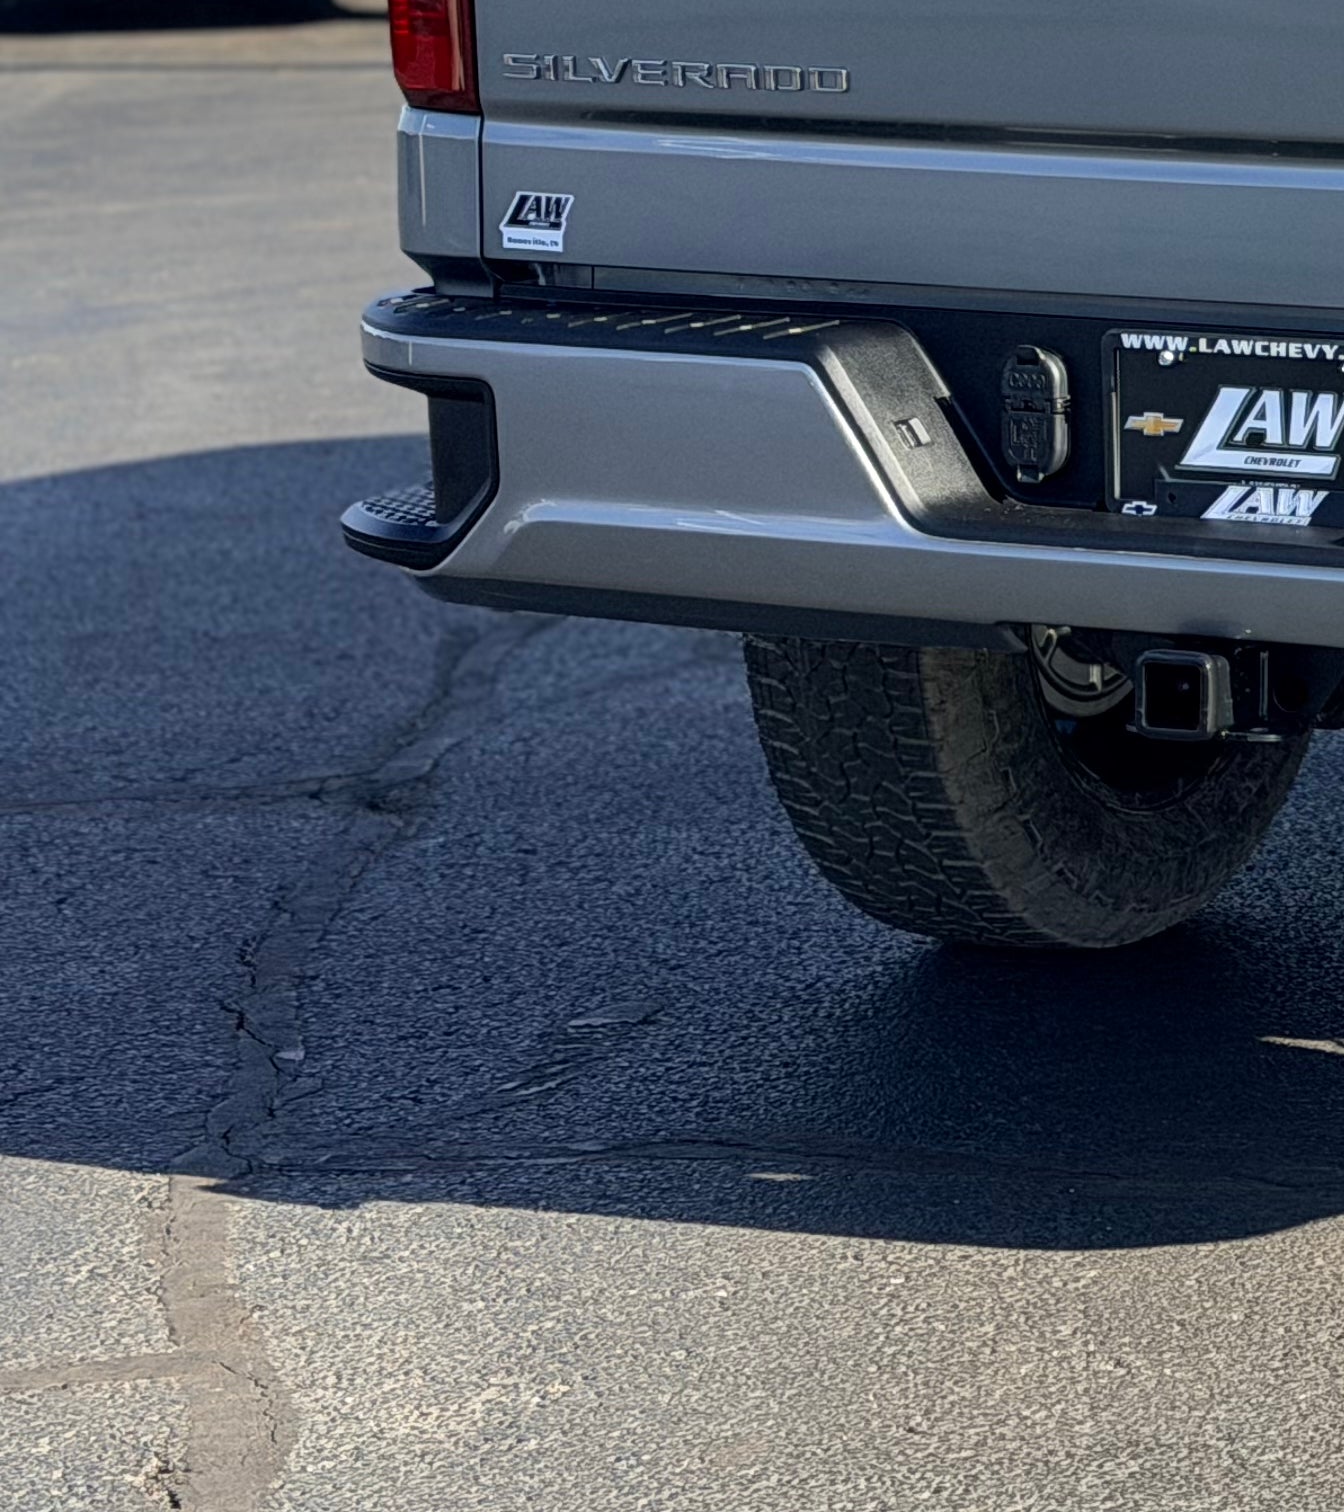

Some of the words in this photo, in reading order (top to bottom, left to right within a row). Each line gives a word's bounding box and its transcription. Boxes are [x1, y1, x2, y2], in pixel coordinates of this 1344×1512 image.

[502, 52, 850, 93] SILVERADO
[502, 194, 573, 230] LAW
[1244, 456, 1302, 468] CHEVROLET
[1200, 485, 1330, 525] LAW
